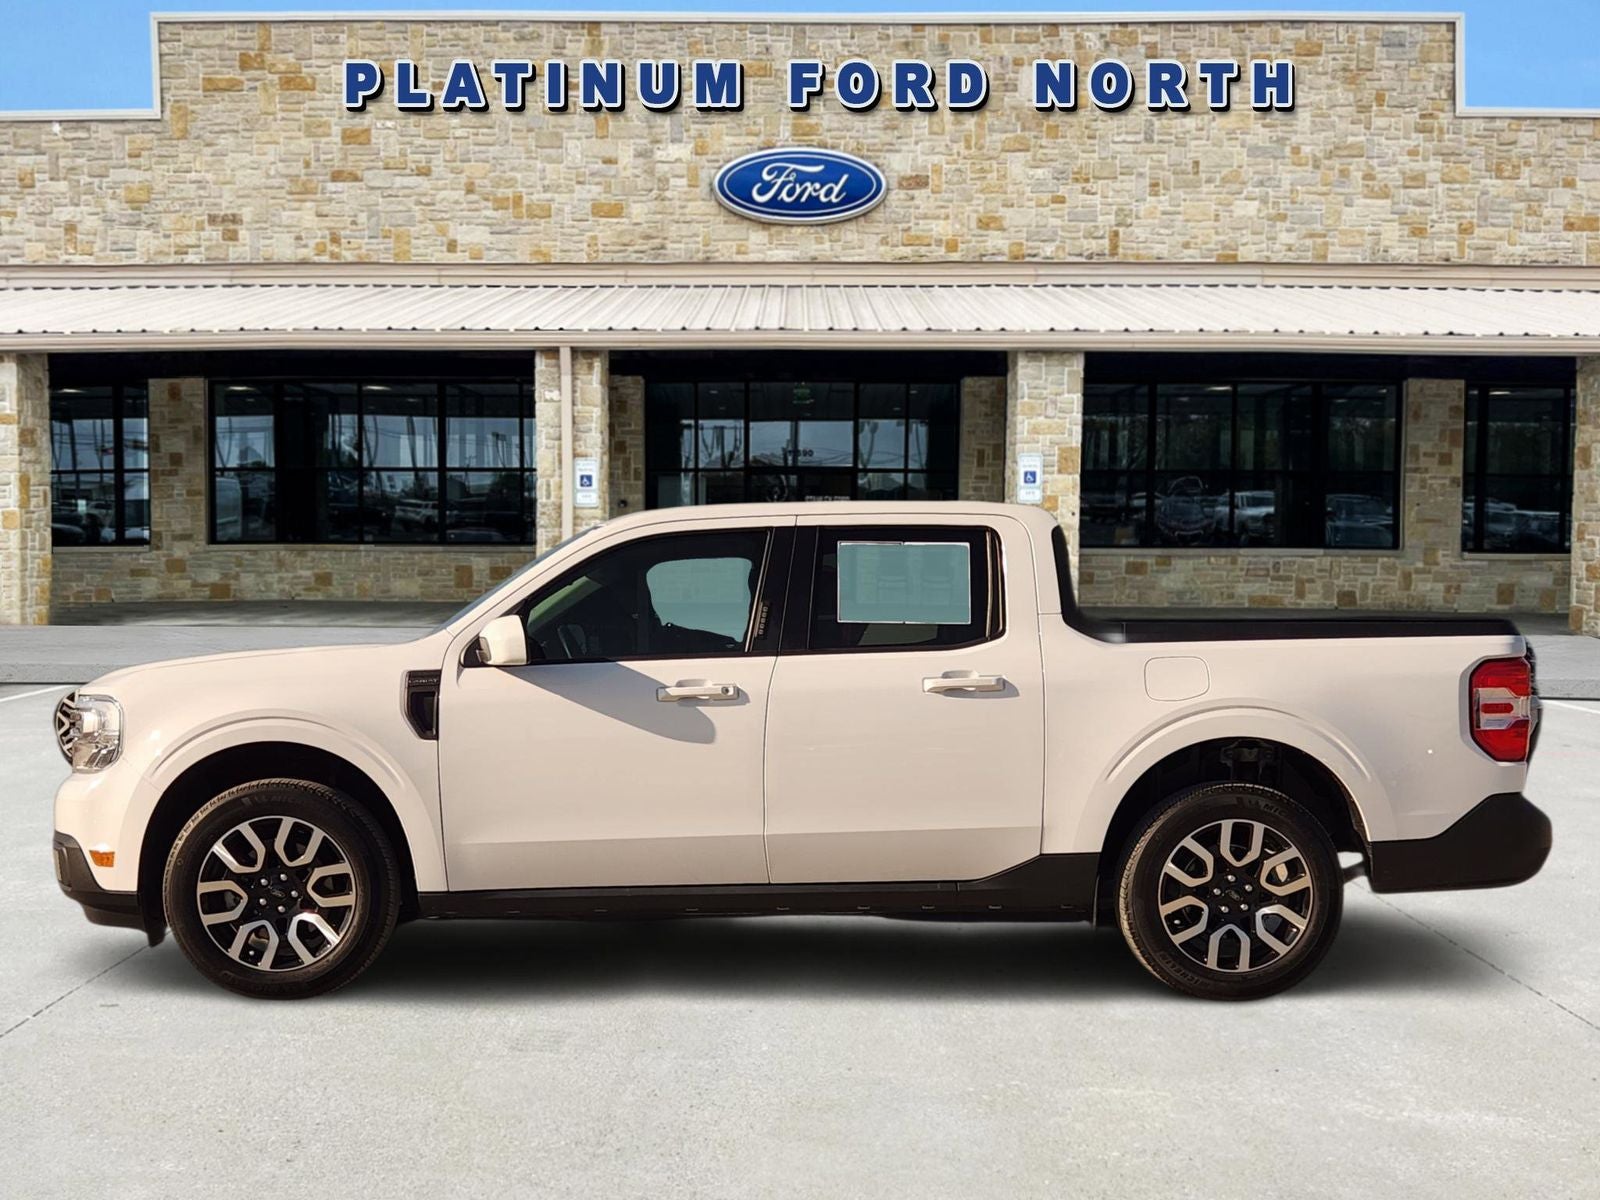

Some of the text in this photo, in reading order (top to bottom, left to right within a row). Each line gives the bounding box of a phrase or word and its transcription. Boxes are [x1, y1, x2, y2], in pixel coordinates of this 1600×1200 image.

[343, 59, 1296, 111] PLATINUM FORD NORTH
[752, 162, 849, 204] Ford
